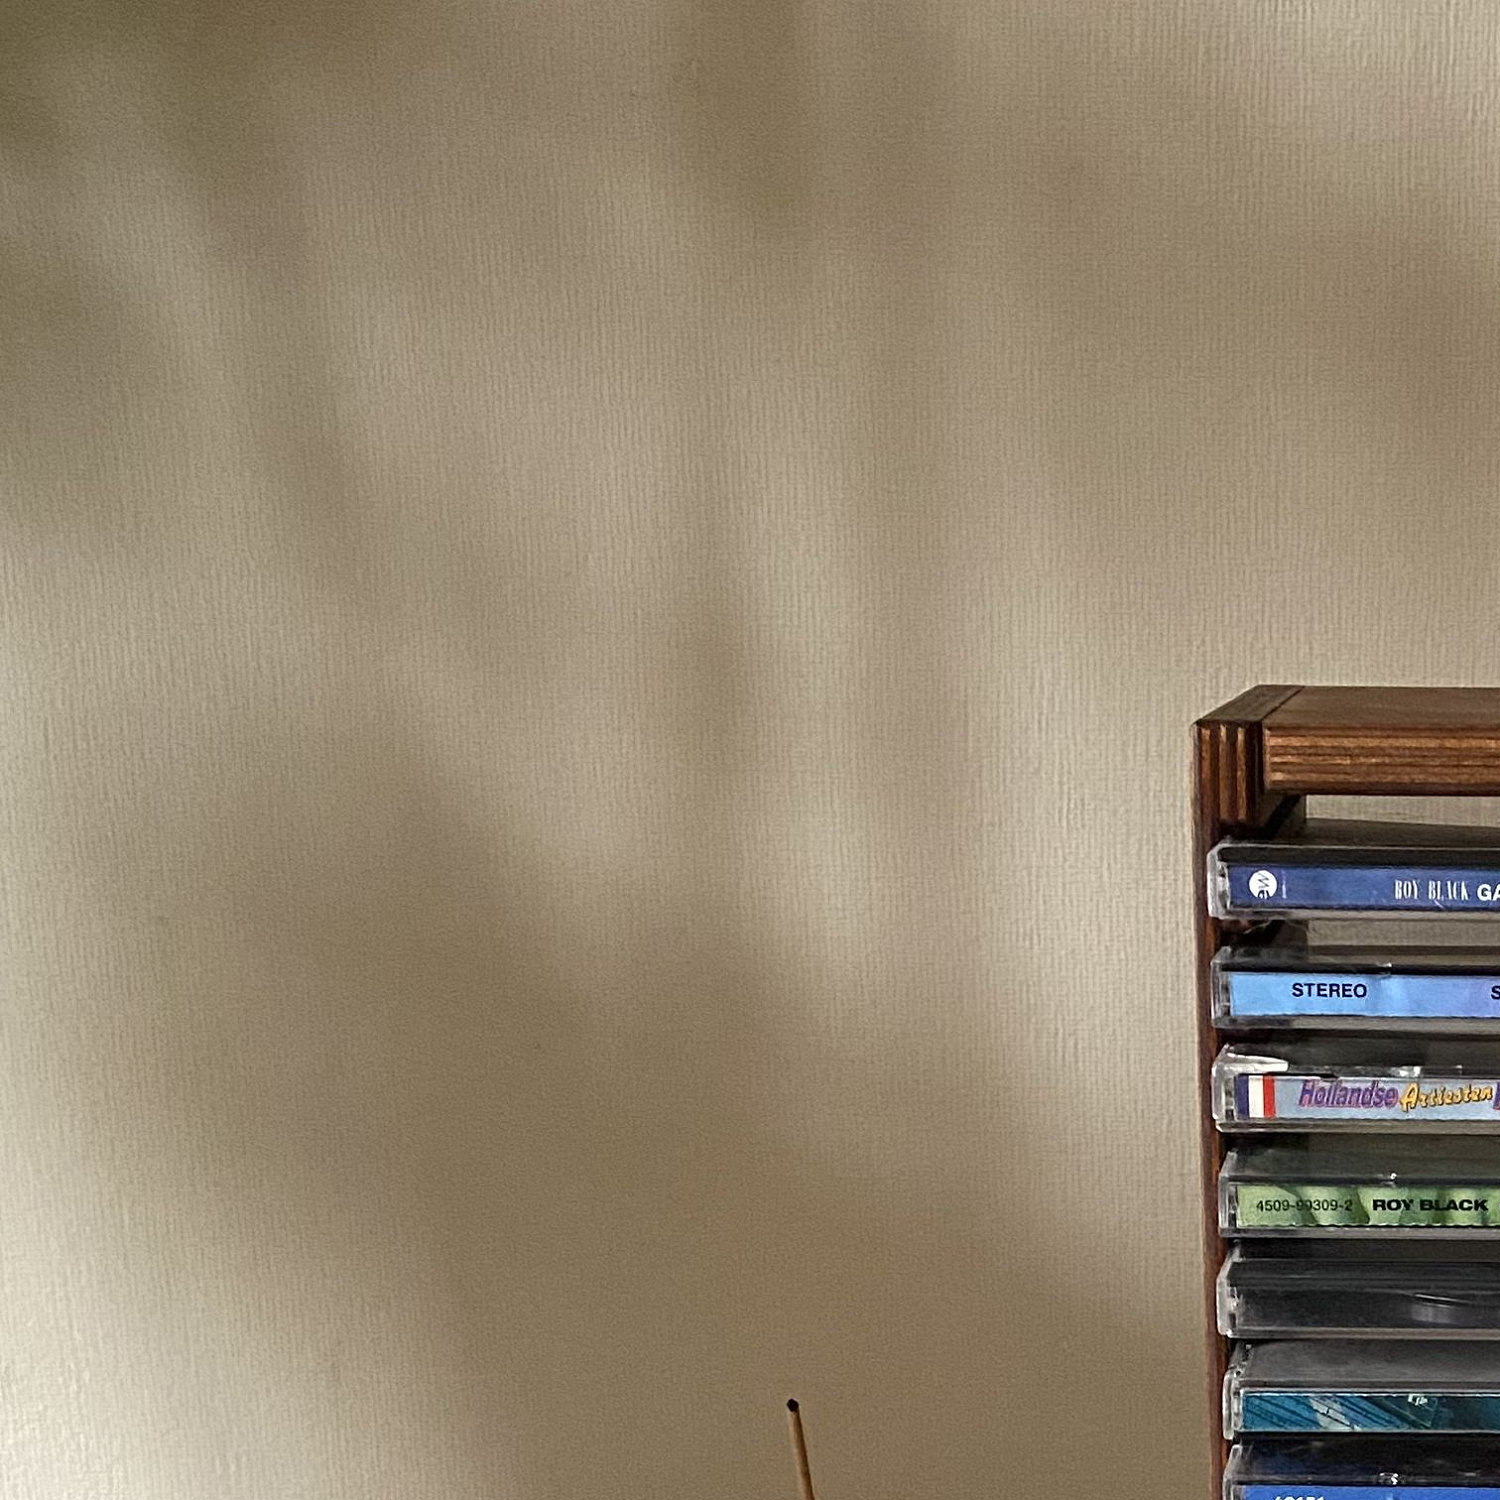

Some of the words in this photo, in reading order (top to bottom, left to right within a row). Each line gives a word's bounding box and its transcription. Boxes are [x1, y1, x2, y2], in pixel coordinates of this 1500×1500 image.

[1428, 879, 1469, 901] BLACK
[1291, 983, 1368, 998] STEREO
[1300, 1079, 1400, 1109] Hollandse
[1372, 1198, 1414, 1212] ROY
[1420, 1198, 1488, 1212] BLACK
